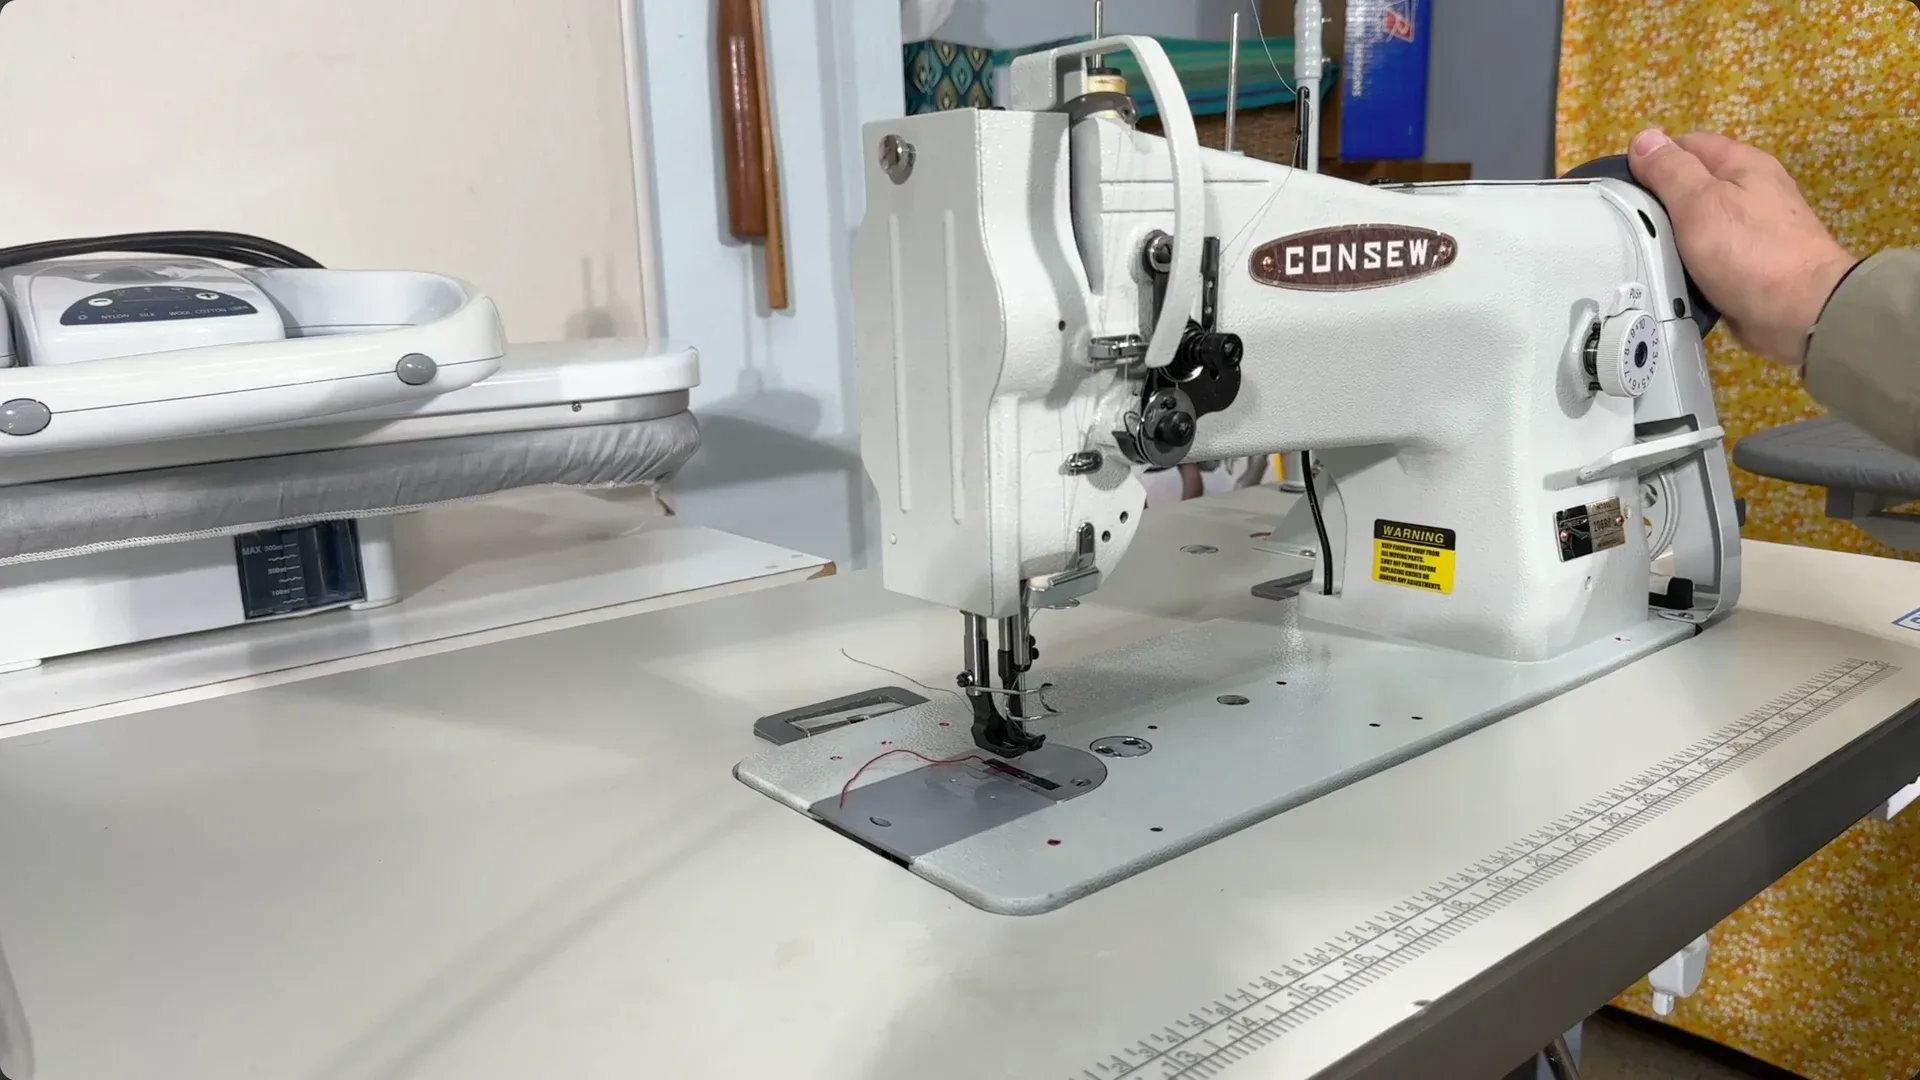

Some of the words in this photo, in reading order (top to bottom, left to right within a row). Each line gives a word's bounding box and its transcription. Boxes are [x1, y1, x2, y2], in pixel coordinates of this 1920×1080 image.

[1284, 239, 1429, 276] CONSEW
[1629, 287, 1642, 300] PUSH
[101, 313, 130, 321] NYLON
[195, 307, 227, 315] COTTON
[1383, 525, 1445, 544] WARNING
[242, 545, 262, 556] MAX
[1161, 1050, 1199, 1071] 13
[1227, 1016, 1260, 1035] 14
[1287, 982, 1321, 1001] 15
[1343, 953, 1374, 970] 16
[1394, 925, 1421, 941] 17
[1442, 900, 1472, 914] 18
[1486, 876, 1513, 889] 19
[1526, 853, 1554, 868] 20
[1565, 833, 1592, 847] 21
[1601, 812, 1630, 825] 22
[1635, 793, 1662, 805] 23
[1668, 775, 1690, 787] 24
[1698, 758, 1722, 768] 25
[1727, 741, 1751, 752] 26
[1753, 726, 1774, 737] 27
